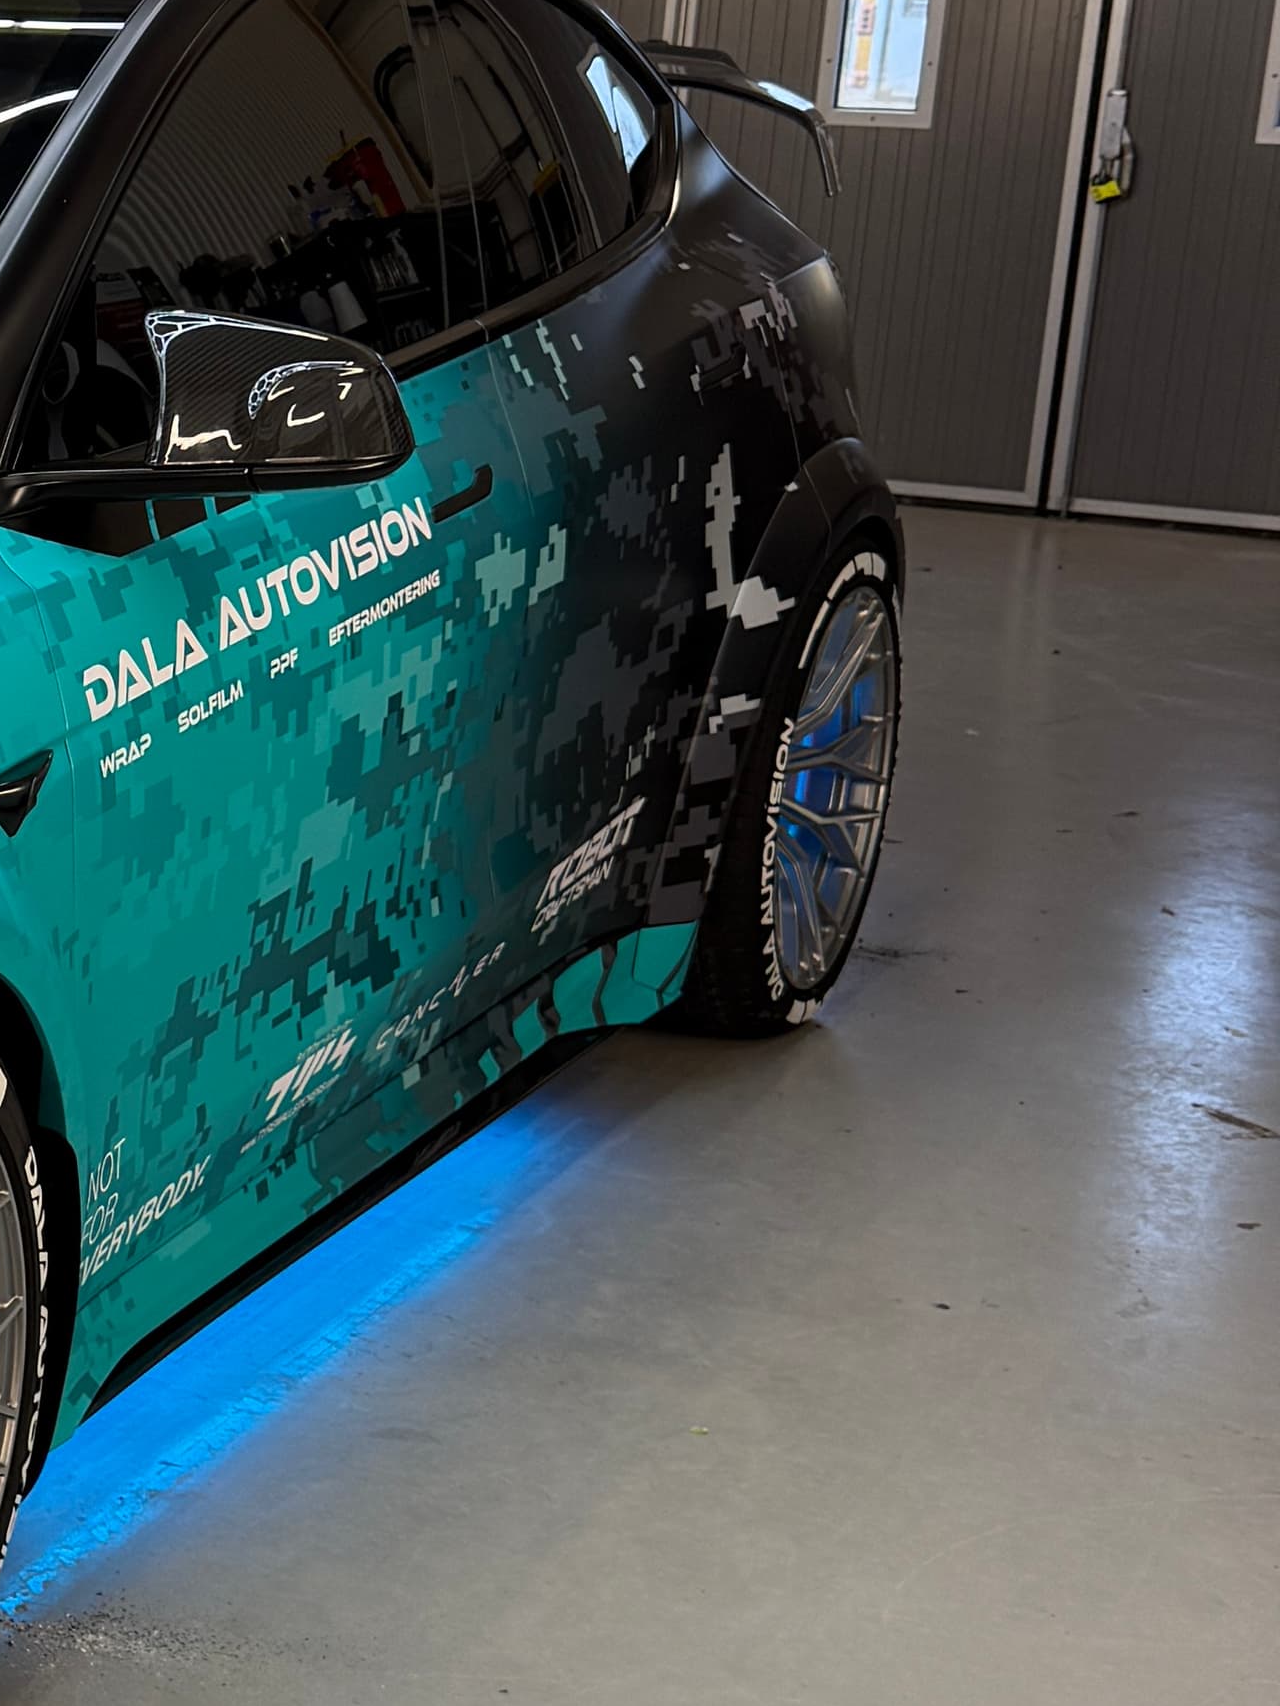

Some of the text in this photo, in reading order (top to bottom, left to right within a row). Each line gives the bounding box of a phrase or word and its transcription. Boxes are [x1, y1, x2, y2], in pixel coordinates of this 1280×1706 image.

[81, 496, 433, 722] DALA AUTOVISION
[100, 568, 441, 779] WRAP SOLFILM PPF EFTERMONTERING
[536, 796, 647, 911] ROBOT
[760, 717, 794, 925] AUTOVISION
[80, 1192, 119, 1249] FOR
[86, 1137, 126, 1211] NOT
